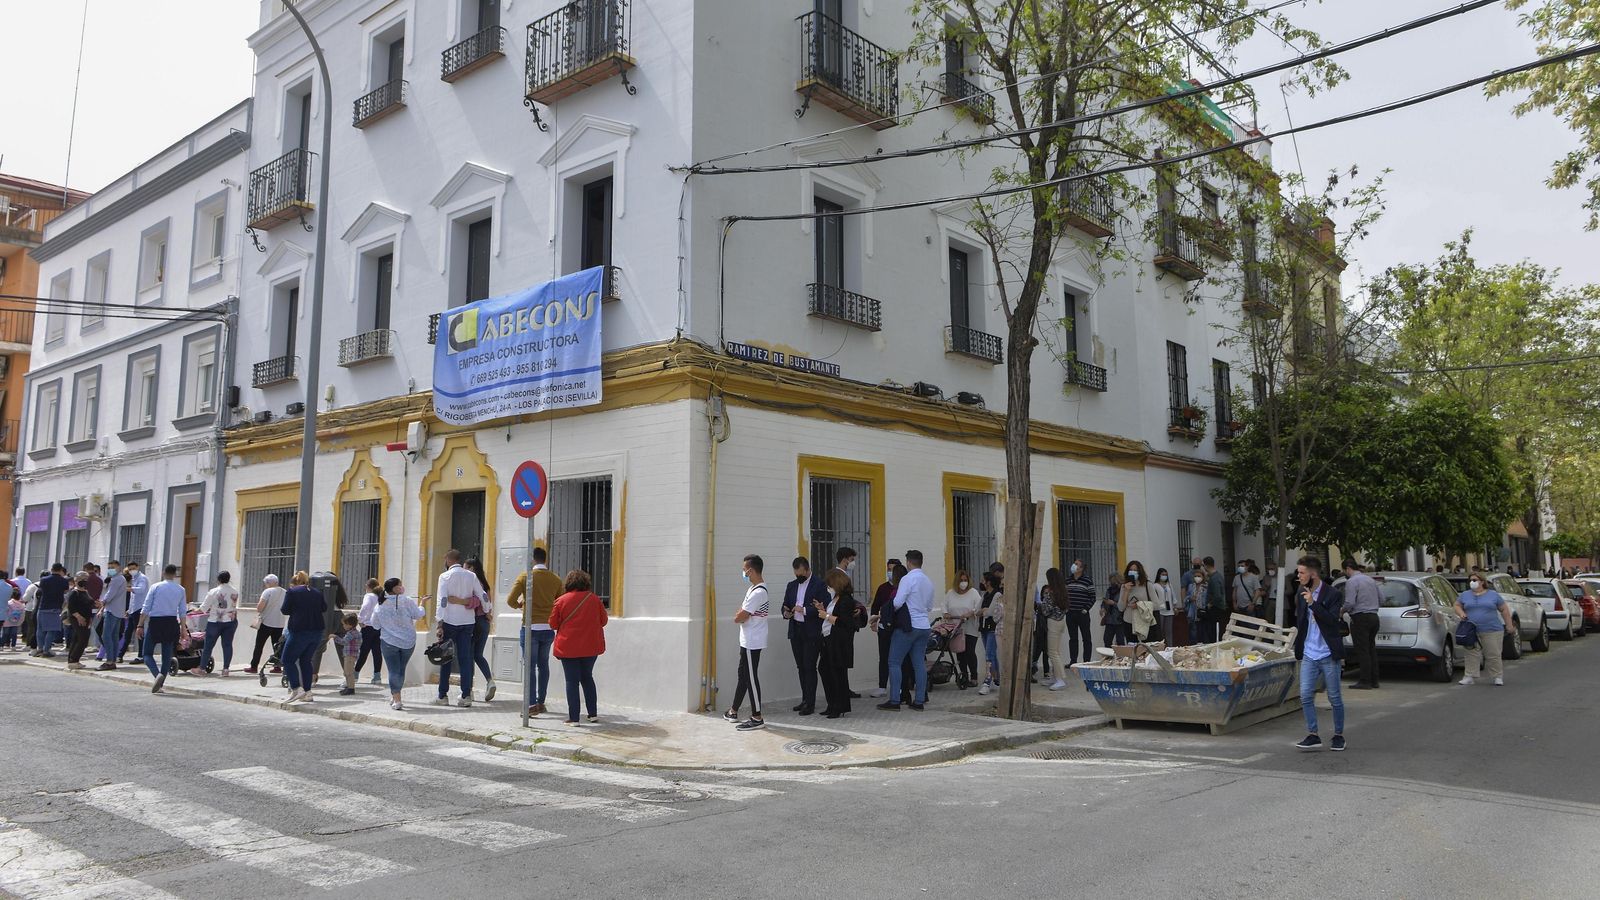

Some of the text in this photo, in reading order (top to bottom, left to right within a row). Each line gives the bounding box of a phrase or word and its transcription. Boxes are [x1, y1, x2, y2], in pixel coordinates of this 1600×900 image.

[458, 333, 579, 370] EMPRESA CONSTRUCTORA
[728, 342, 840, 375] RAMIREZ DE BUSTAMANTE
[487, 370, 499, 381] 525
[499, 366, 511, 377] 493
[516, 363, 529, 375] 955
[518, 400, 532, 409] LOS
[533, 395, 564, 408] PAACIOS
[565, 390, 598, 404] (SEVILLA)
